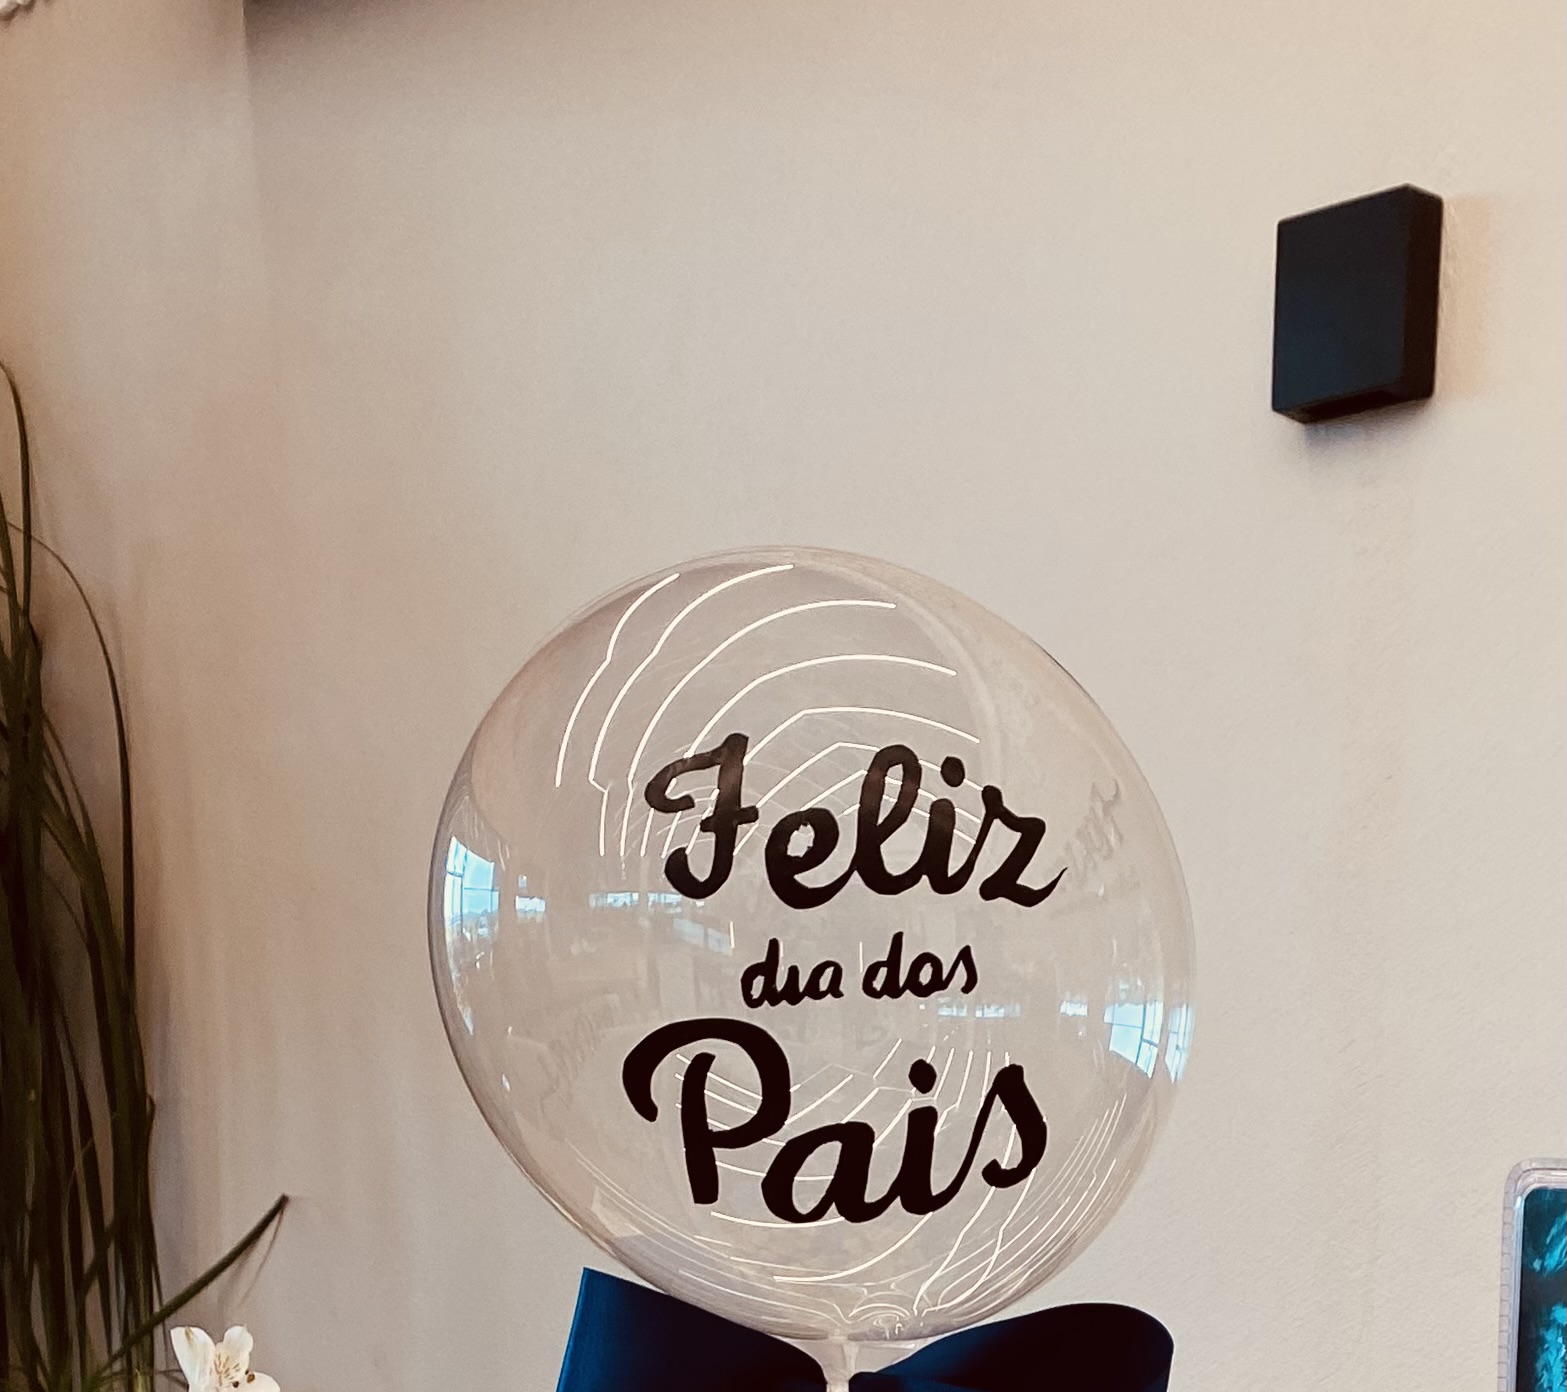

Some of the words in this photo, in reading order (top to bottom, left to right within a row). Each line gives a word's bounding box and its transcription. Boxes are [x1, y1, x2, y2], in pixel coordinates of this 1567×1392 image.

[645, 733, 1068, 910] Feliz
[741, 937, 845, 1009] dia
[862, 931, 978, 1000] dos
[623, 1018, 1048, 1224] Pais
